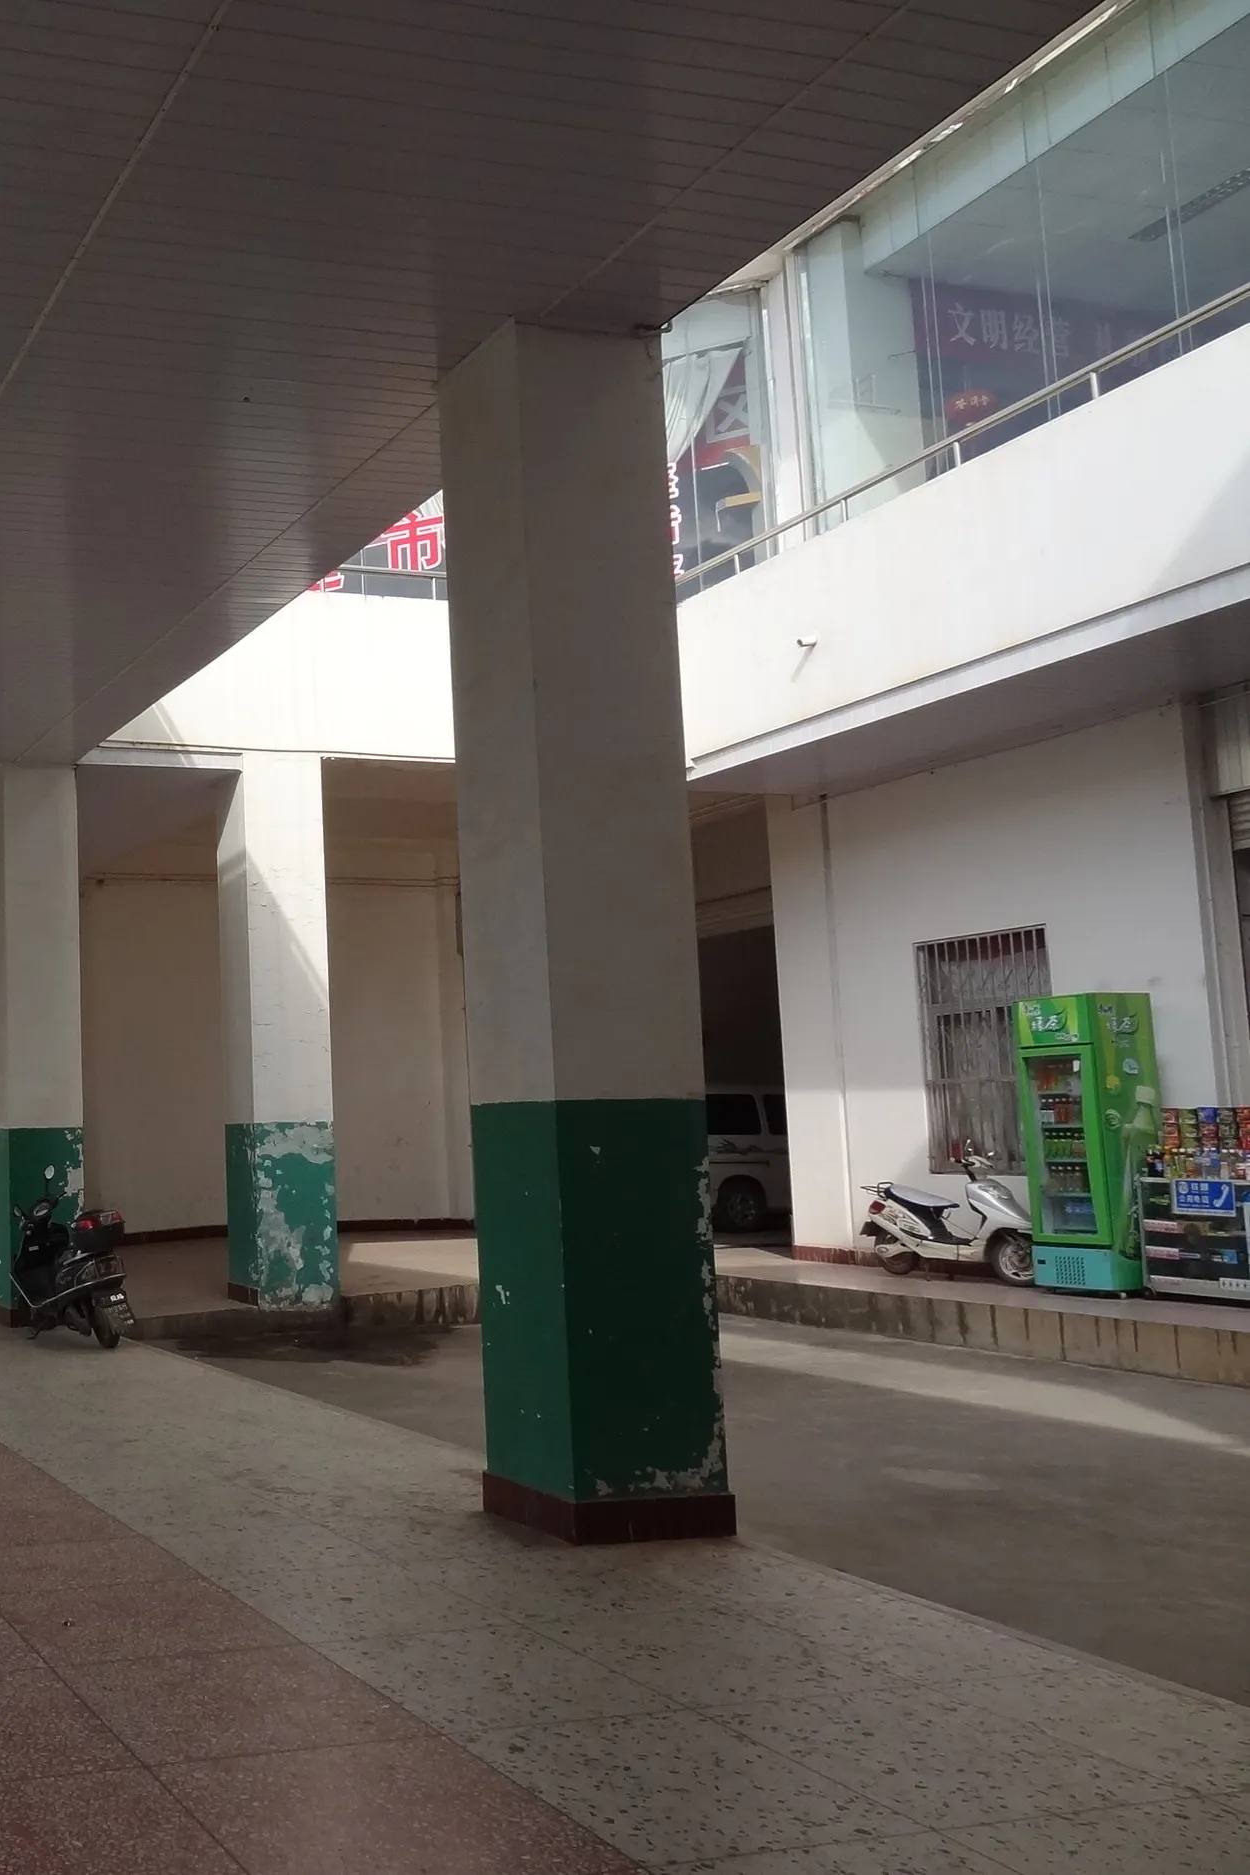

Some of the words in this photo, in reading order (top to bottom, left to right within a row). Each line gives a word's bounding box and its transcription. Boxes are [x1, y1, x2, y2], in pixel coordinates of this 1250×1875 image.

[947, 303, 1070, 358] 文明经营
[380, 509, 445, 572] 市
